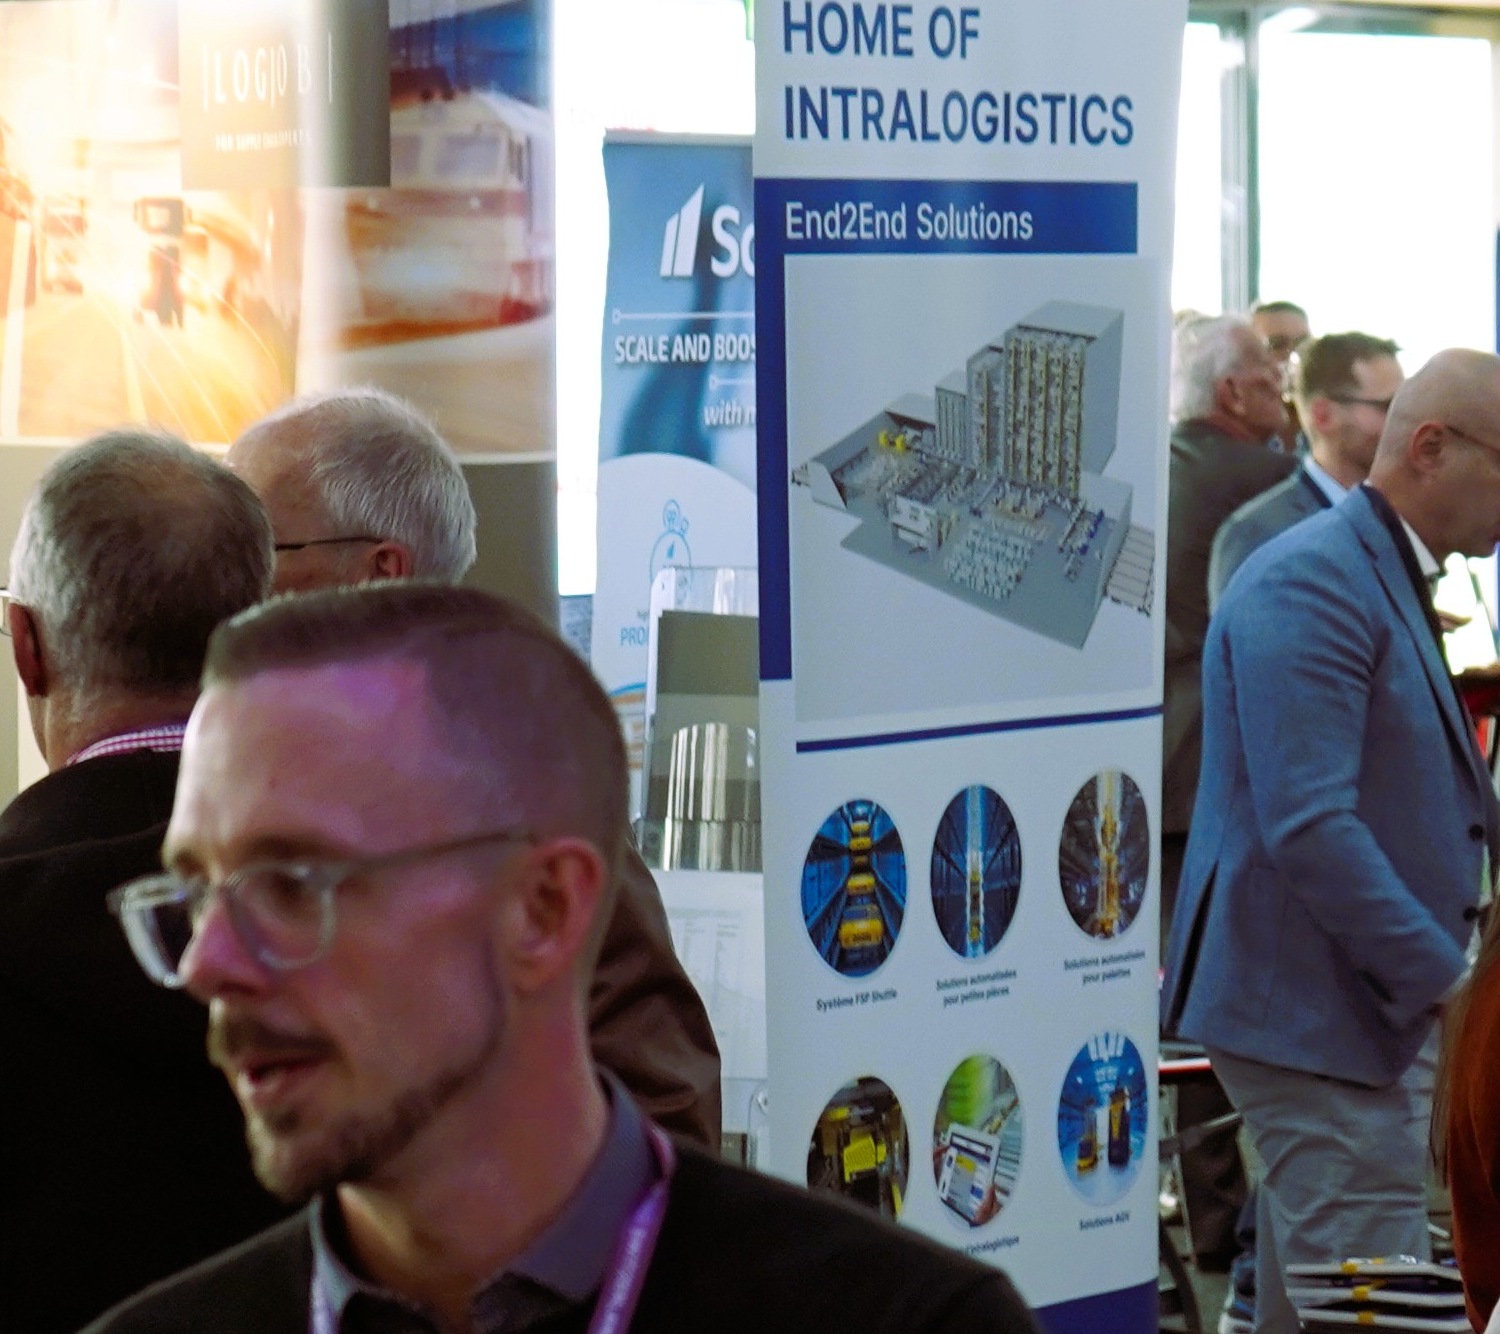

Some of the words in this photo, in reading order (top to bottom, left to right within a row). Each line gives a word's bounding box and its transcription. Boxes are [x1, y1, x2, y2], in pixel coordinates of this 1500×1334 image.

[783, 0, 913, 57] HOME
[928, 6, 980, 58] OF
[784, 85, 1134, 146] INTRALOGISTICS
[786, 201, 906, 240] End2End
[916, 202, 1033, 240] Solutions
[615, 335, 669, 363] SCALE
[671, 334, 710, 362] AND
[704, 400, 742, 426] with
[816, 995, 853, 1012] Système
[872, 988, 897, 1002] Shuttle
